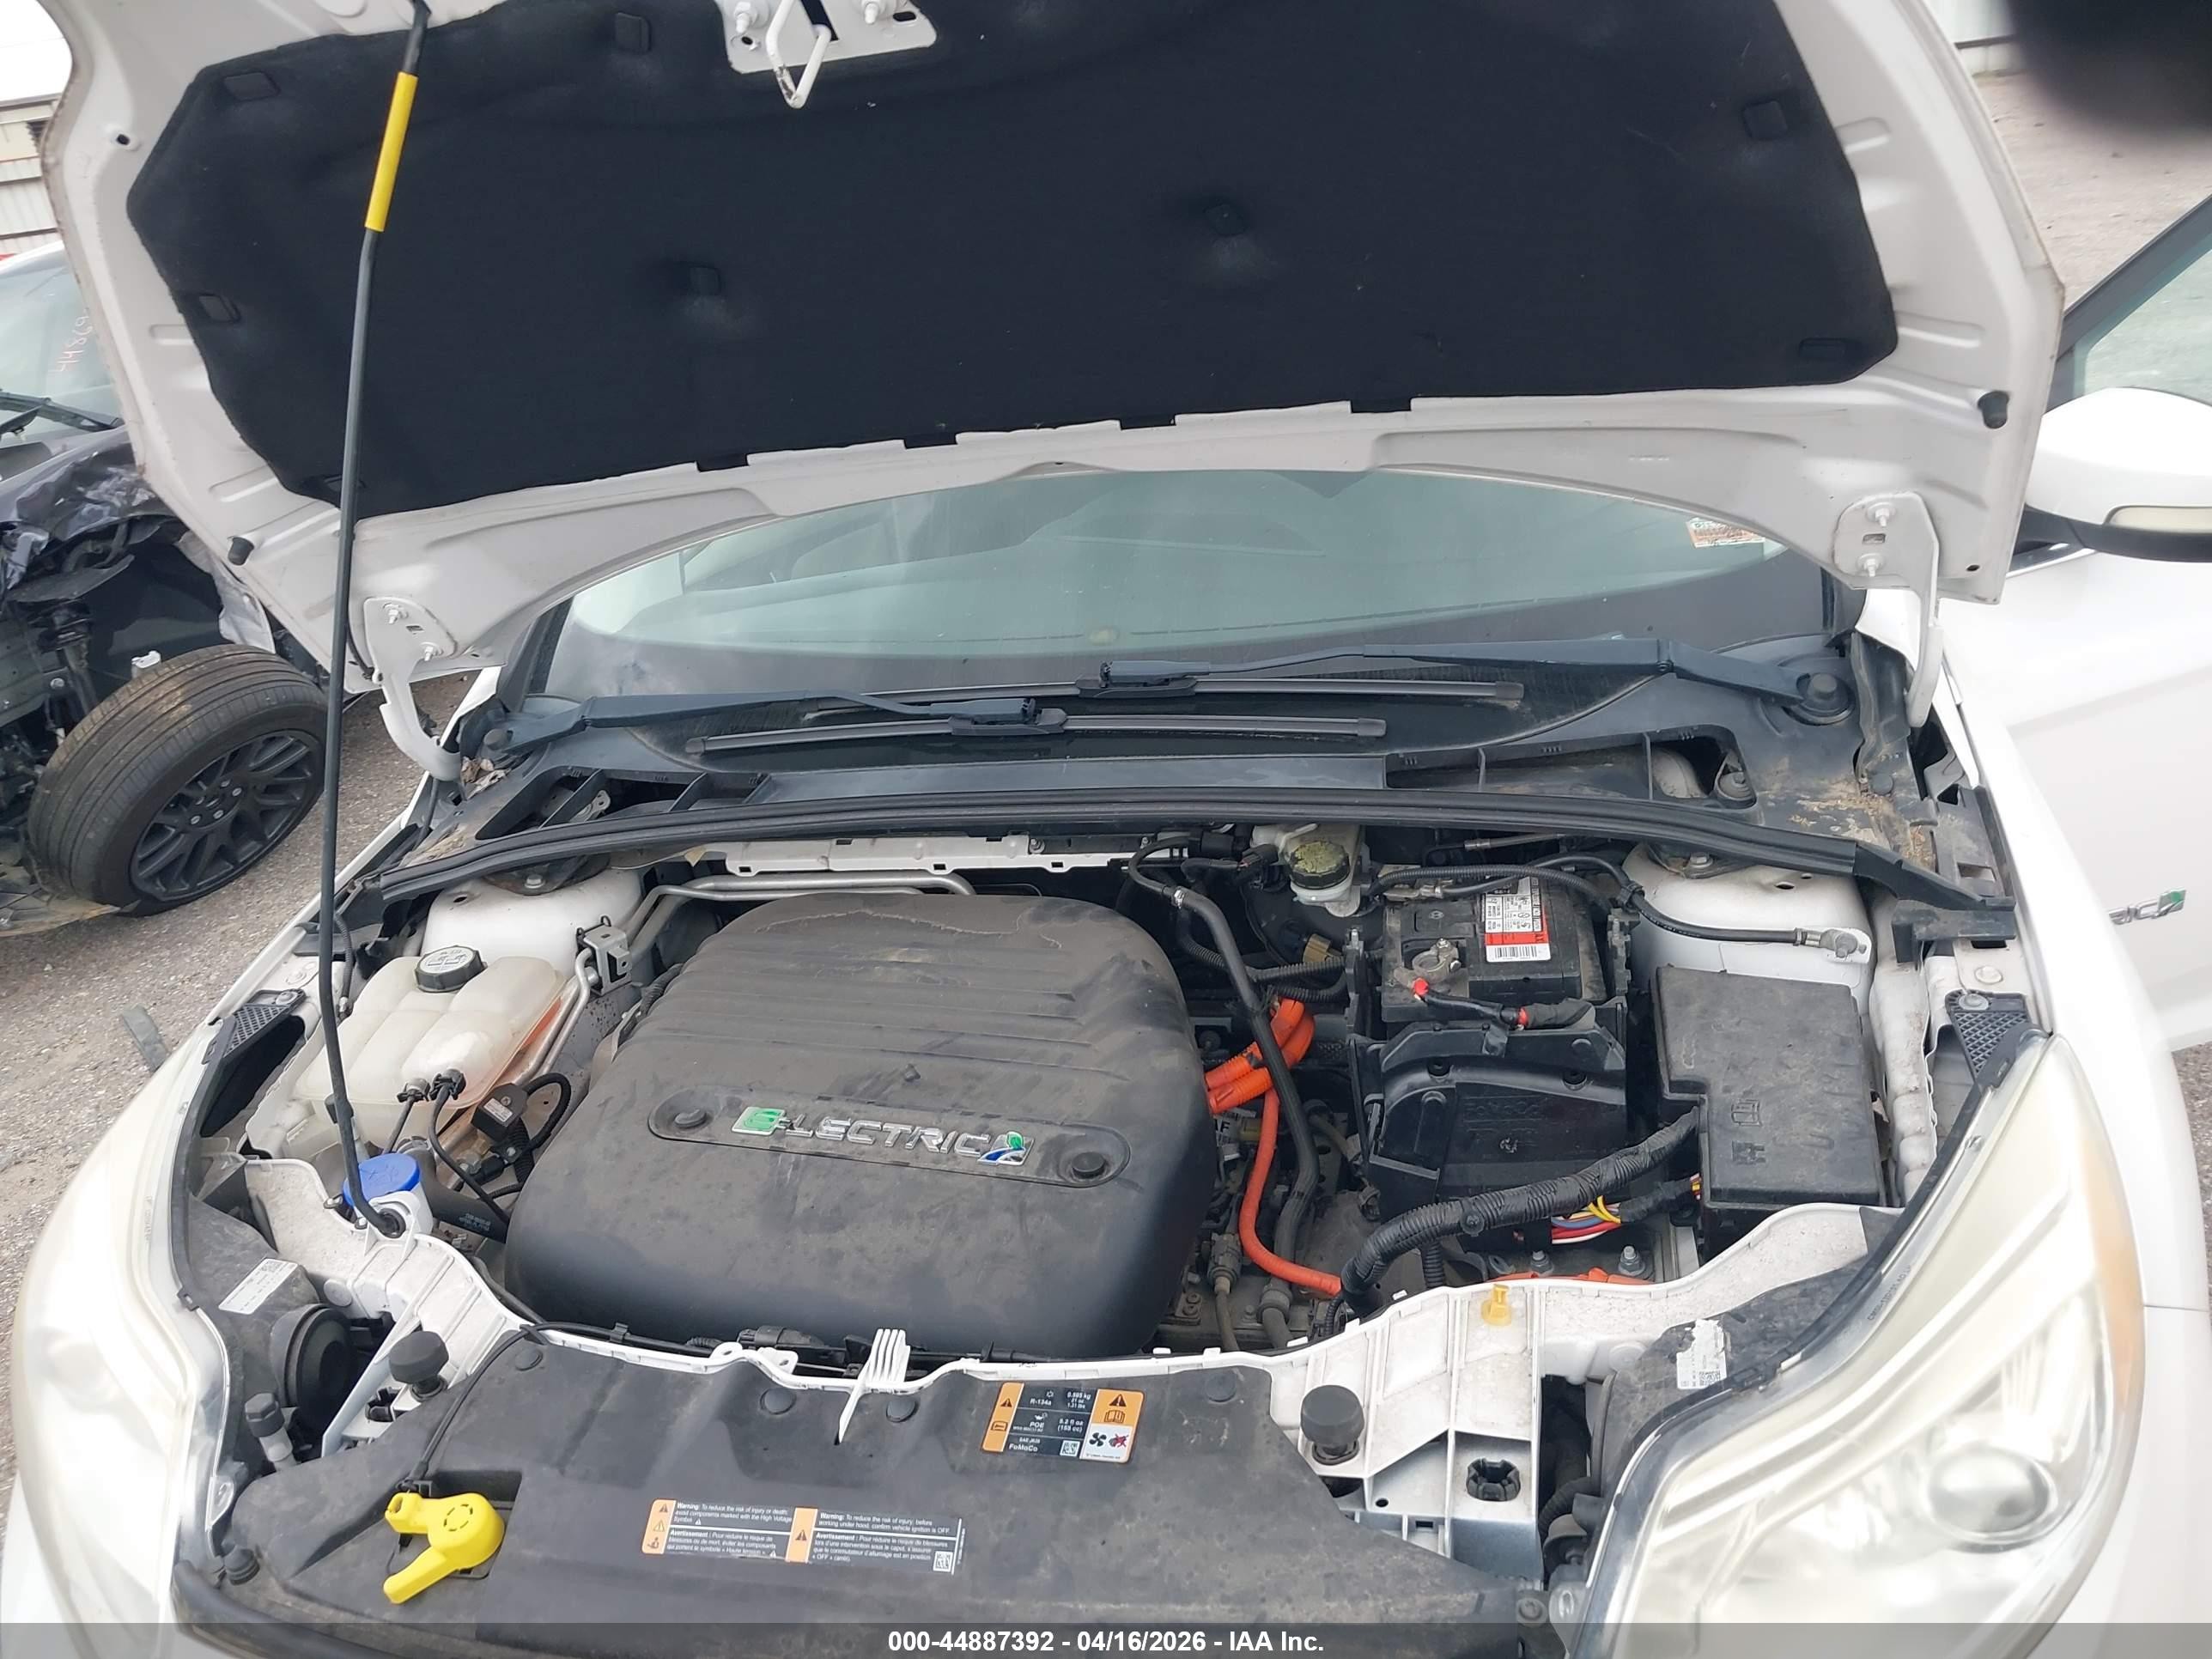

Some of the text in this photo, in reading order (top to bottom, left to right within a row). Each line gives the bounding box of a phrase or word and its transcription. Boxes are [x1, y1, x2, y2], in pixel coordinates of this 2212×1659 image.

[1008, 1443, 1037, 1452] FoMoCo
[819, 1512, 845, 1521] Warning:
[670, 1528, 708, 1537] Avertissement
[910, 1525, 931, 1534] ignition
[816, 1531, 855, 1540] Avertissement
